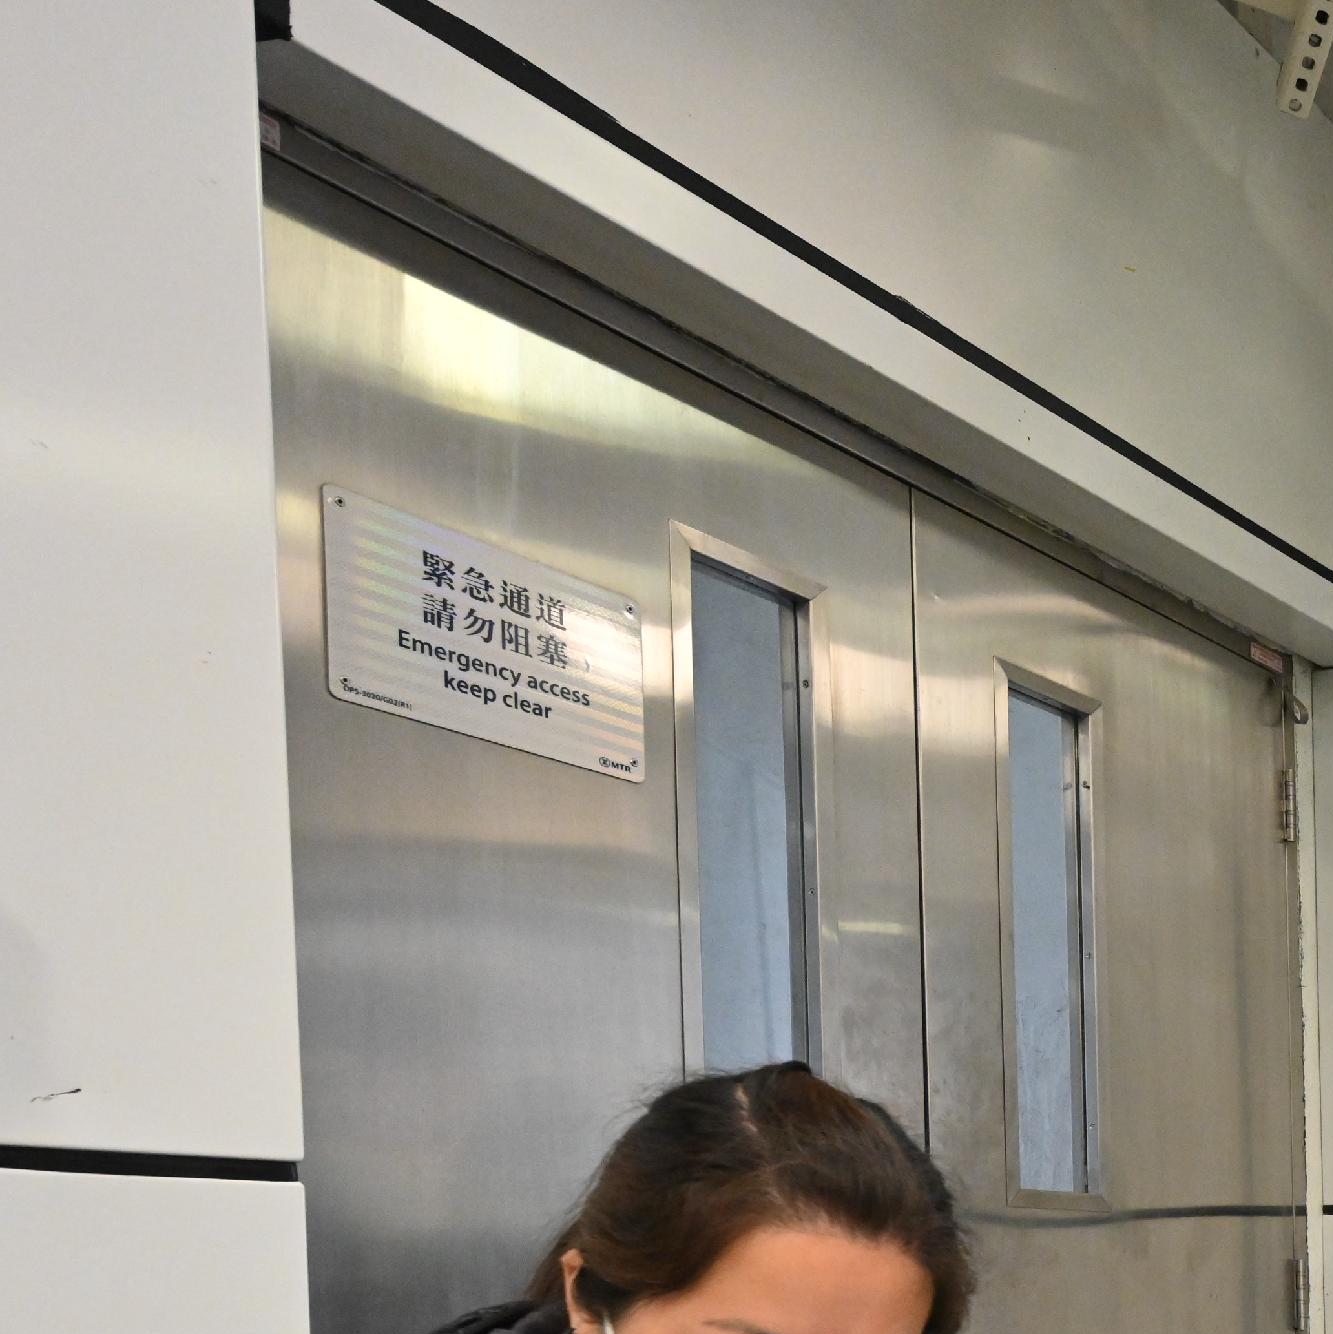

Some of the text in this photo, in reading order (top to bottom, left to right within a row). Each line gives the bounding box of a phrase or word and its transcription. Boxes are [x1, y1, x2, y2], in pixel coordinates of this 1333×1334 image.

[421, 550, 567, 633] 緊急通道
[398, 628, 591, 707] Emergency access
[421, 593, 569, 670] 請勿阻塞
[443, 670, 553, 719] keep clear
[611, 761, 631, 774] MTR
